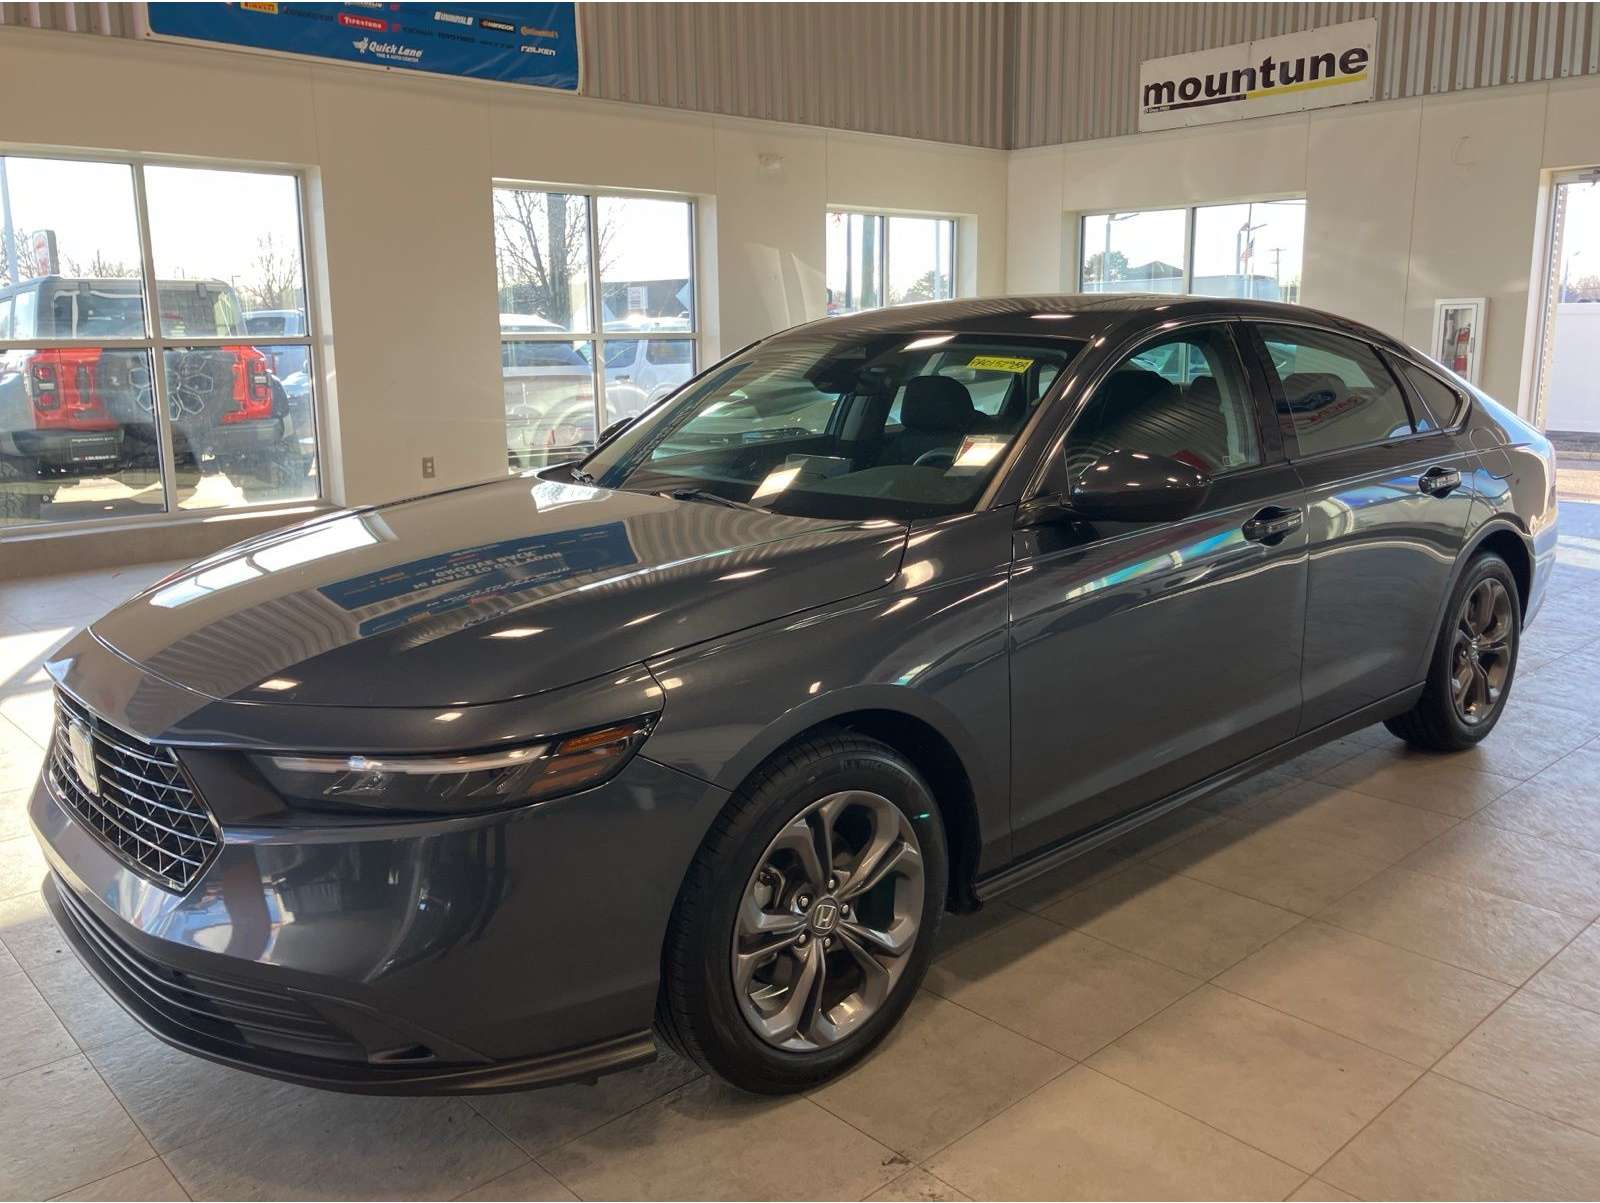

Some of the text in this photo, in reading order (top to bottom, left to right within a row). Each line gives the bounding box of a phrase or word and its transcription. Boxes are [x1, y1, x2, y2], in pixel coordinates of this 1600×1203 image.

[369, 41, 423, 58] Quick Lane
[1143, 47, 1369, 107] mountune
